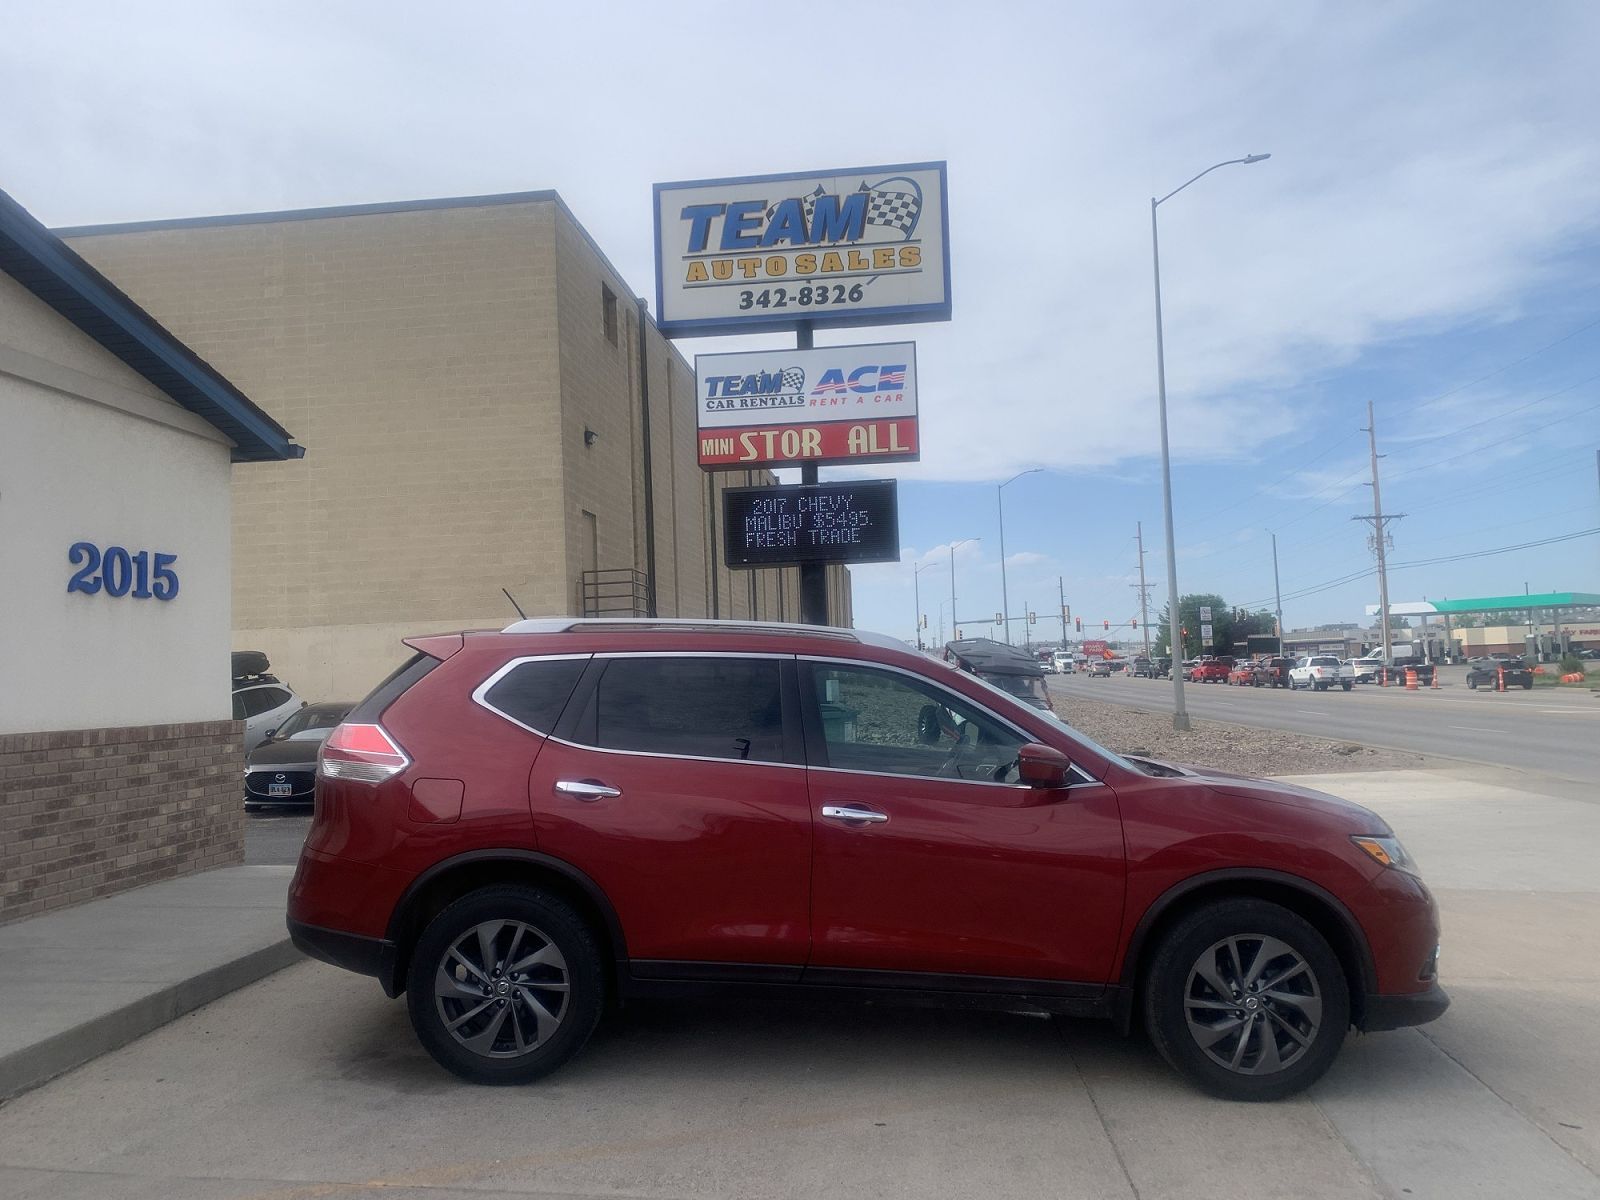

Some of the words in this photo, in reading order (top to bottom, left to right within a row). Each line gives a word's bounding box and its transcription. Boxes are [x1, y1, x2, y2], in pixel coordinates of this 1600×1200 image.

[680, 192, 870, 253] TEAM
[686, 256, 788, 281] AUTO
[795, 247, 922, 275] SALES
[739, 283, 864, 310] 342-8326
[705, 373, 783, 397] TEAM
[810, 364, 907, 395] ACE
[706, 399, 735, 409] CAR
[740, 395, 805, 408] RENTALS
[809, 397, 847, 407] RENT
[856, 396, 864, 404] A
[874, 393, 903, 402] CAR
[702, 438, 734, 456] MINI
[739, 428, 822, 461] STOR
[848, 423, 909, 454] ALL
[753, 498, 787, 515] 2017
[798, 494, 853, 512] CHEVY
[745, 514, 802, 531] MALIBU
[746, 530, 797, 548] FRESH
[808, 527, 861, 545] TRADE
[67, 542, 179, 600] 2015
